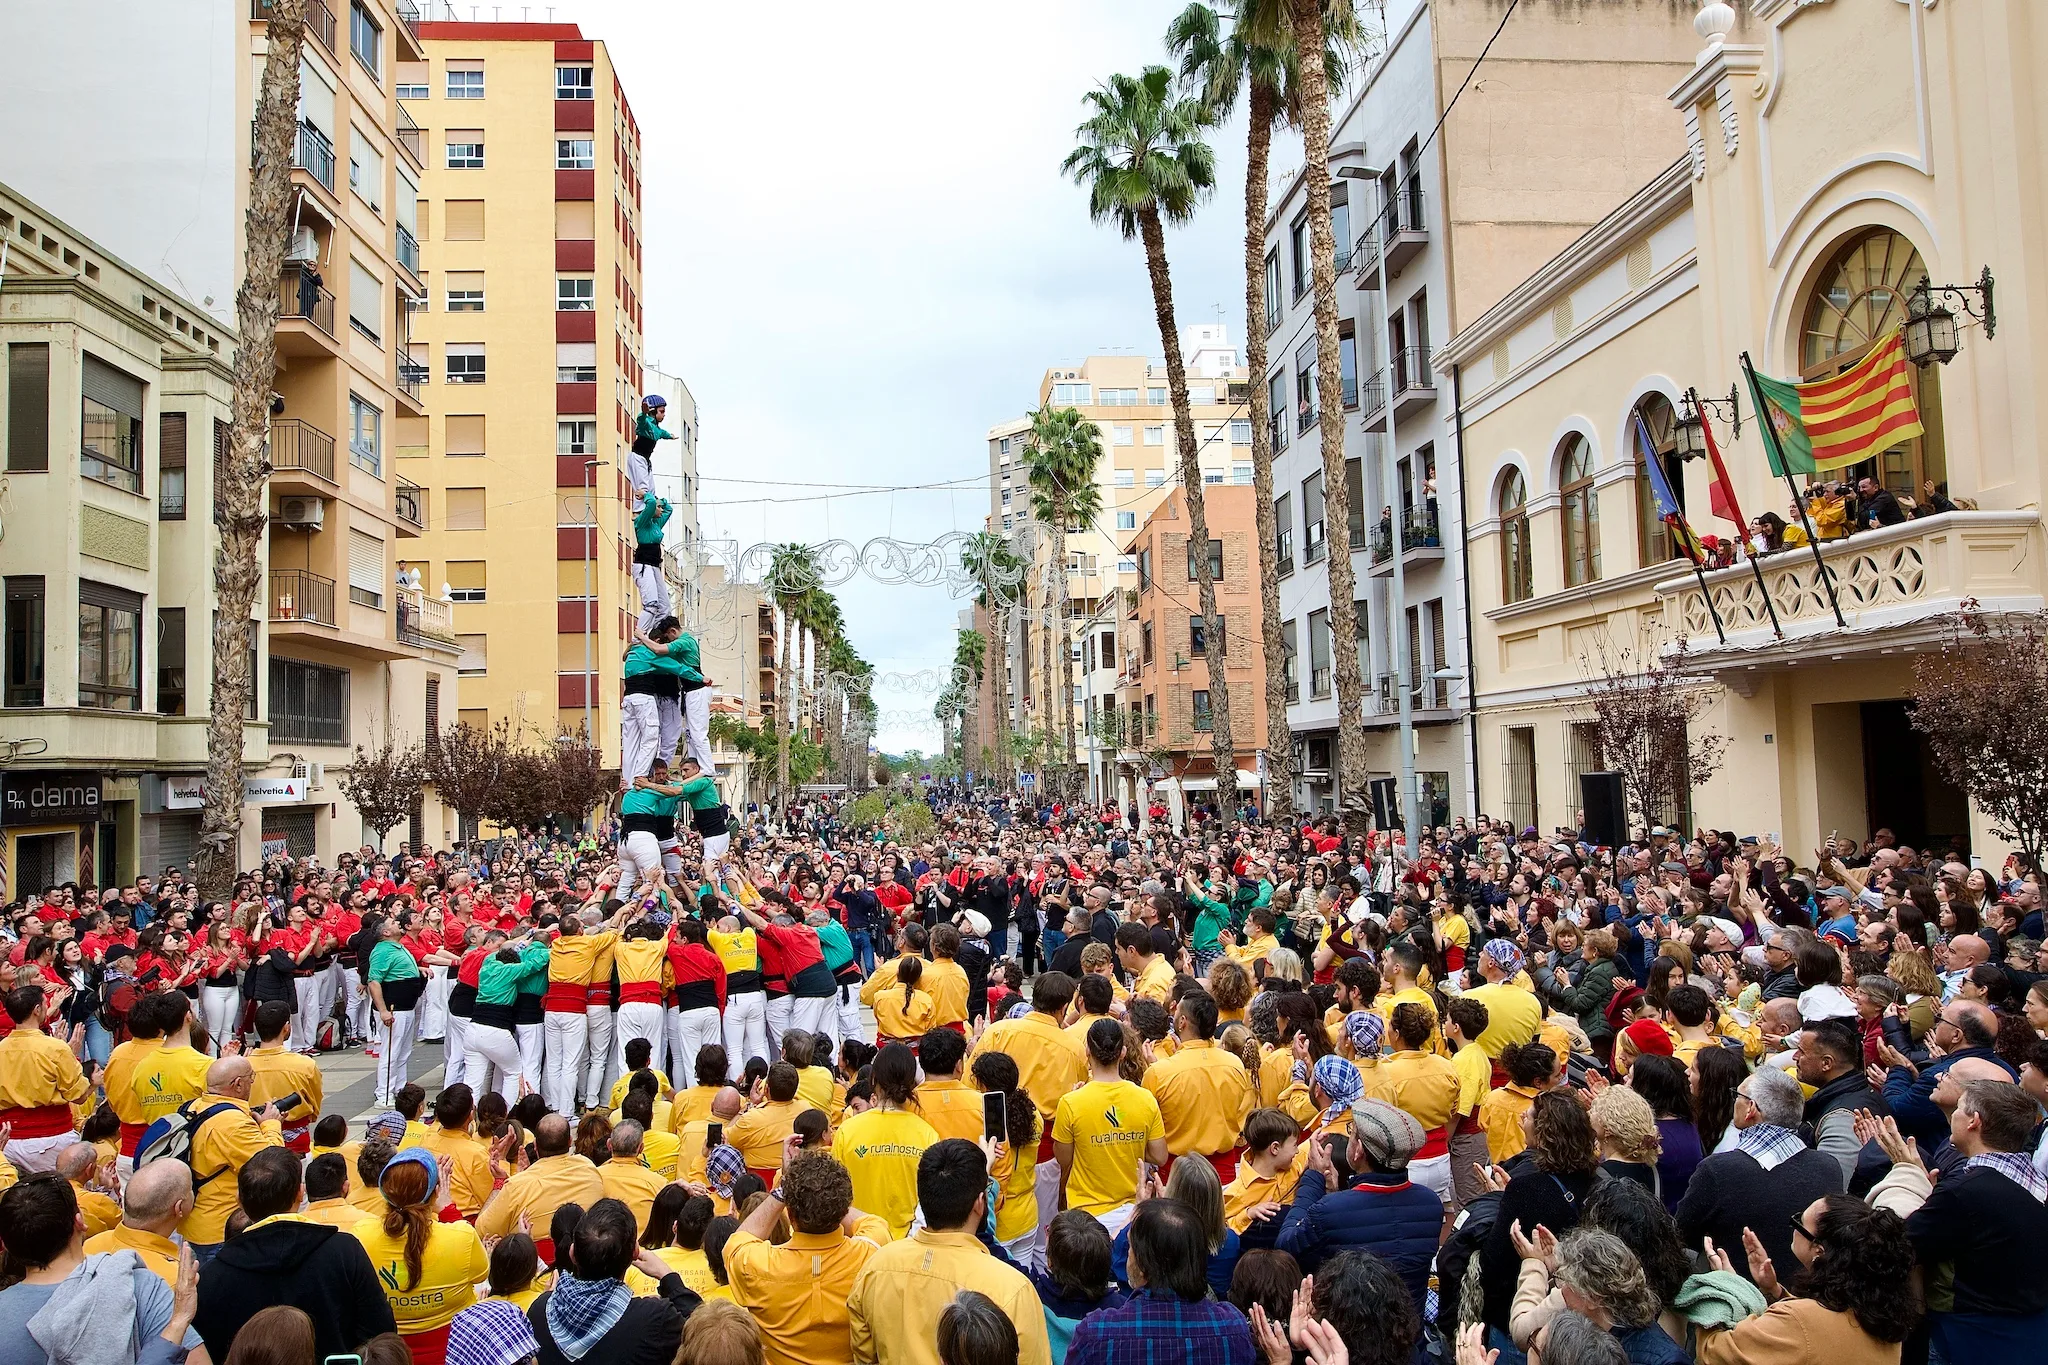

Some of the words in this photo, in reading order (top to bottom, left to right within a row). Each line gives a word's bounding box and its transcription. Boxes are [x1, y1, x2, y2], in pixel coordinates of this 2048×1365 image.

[31, 780, 98, 807] dama
[174, 788, 197, 799] helvetia
[248, 787, 283, 795] helvetia
[30, 806, 98, 817] enmarcaciones
[1090, 1130, 1145, 1144] ruralnostra
[870, 1142, 924, 1157] ruralnostra
